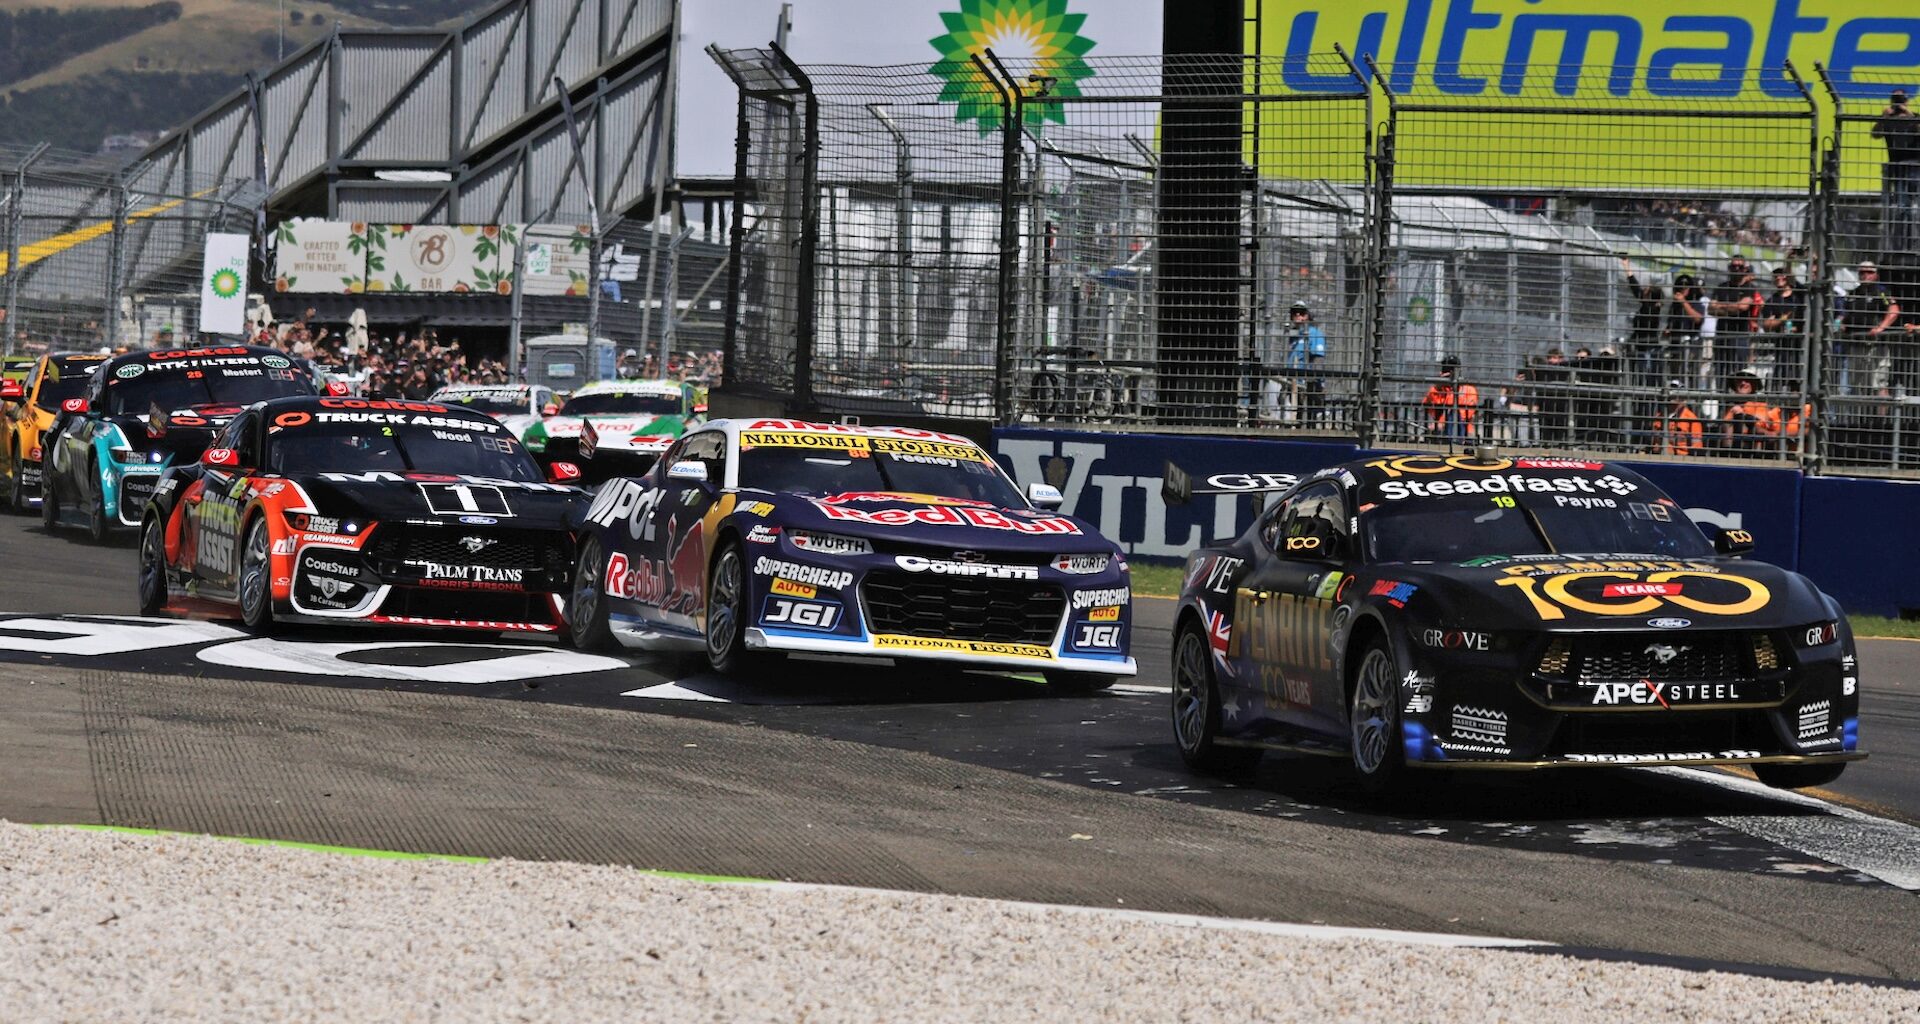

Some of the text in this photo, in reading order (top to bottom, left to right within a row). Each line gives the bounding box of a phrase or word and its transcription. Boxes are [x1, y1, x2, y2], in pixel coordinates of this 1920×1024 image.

[1281, 0, 1920, 100] ultimate
[303, 241, 340, 250] CRAFTED
[231, 256, 244, 266] bp
[306, 253, 337, 261] BETTER
[294, 263, 348, 272] WITH NATURE
[421, 279, 442, 289] BAR
[149, 347, 248, 359] Coates
[147, 357, 259, 370] NTK FILTERS
[222, 369, 263, 377] Mostert
[319, 399, 448, 413] Coates
[315, 413, 406, 424] TRUCK
[411, 415, 500, 433] ASSIST
[551, 422, 636, 433] Catrol
[381, 427, 393, 437] 2
[434, 430, 473, 443] Wood
[745, 433, 982, 460] NATIONAL STORAGE
[891, 453, 958, 467] Feeney
[1379, 475, 1597, 500] Steadfast
[445, 484, 480, 511] 1
[1491, 496, 1516, 509] 19
[1554, 495, 1618, 510] Payne
[309, 514, 340, 526] TRUCK
[307, 523, 339, 534] ASSIST
[302, 533, 355, 545] GEARWRENCH
[1726, 530, 1753, 543] 100
[1287, 537, 1320, 550] 100
[197, 528, 235, 575] ASSIST
[425, 562, 523, 582] PALM TRANS
[754, 555, 853, 591] SUPERCHEAP
[895, 555, 1039, 580] COMPLETE
[419, 578, 525, 591] MORRIS PERSONAL
[776, 581, 812, 594] AUTO
[1614, 584, 1667, 596] YEARS
[318, 596, 346, 609] Caravans
[765, 600, 836, 628] JGI
[1092, 608, 1116, 618] AUTO
[1230, 586, 1333, 672] PENRITE
[1076, 626, 1120, 648] JGI
[1424, 628, 1489, 651] GROVE
[877, 637, 1050, 658] NATIONAL STORAGE
[1592, 679, 1739, 709] APEX STEEL
[1440, 741, 1512, 755] TASMANIAN GIN
